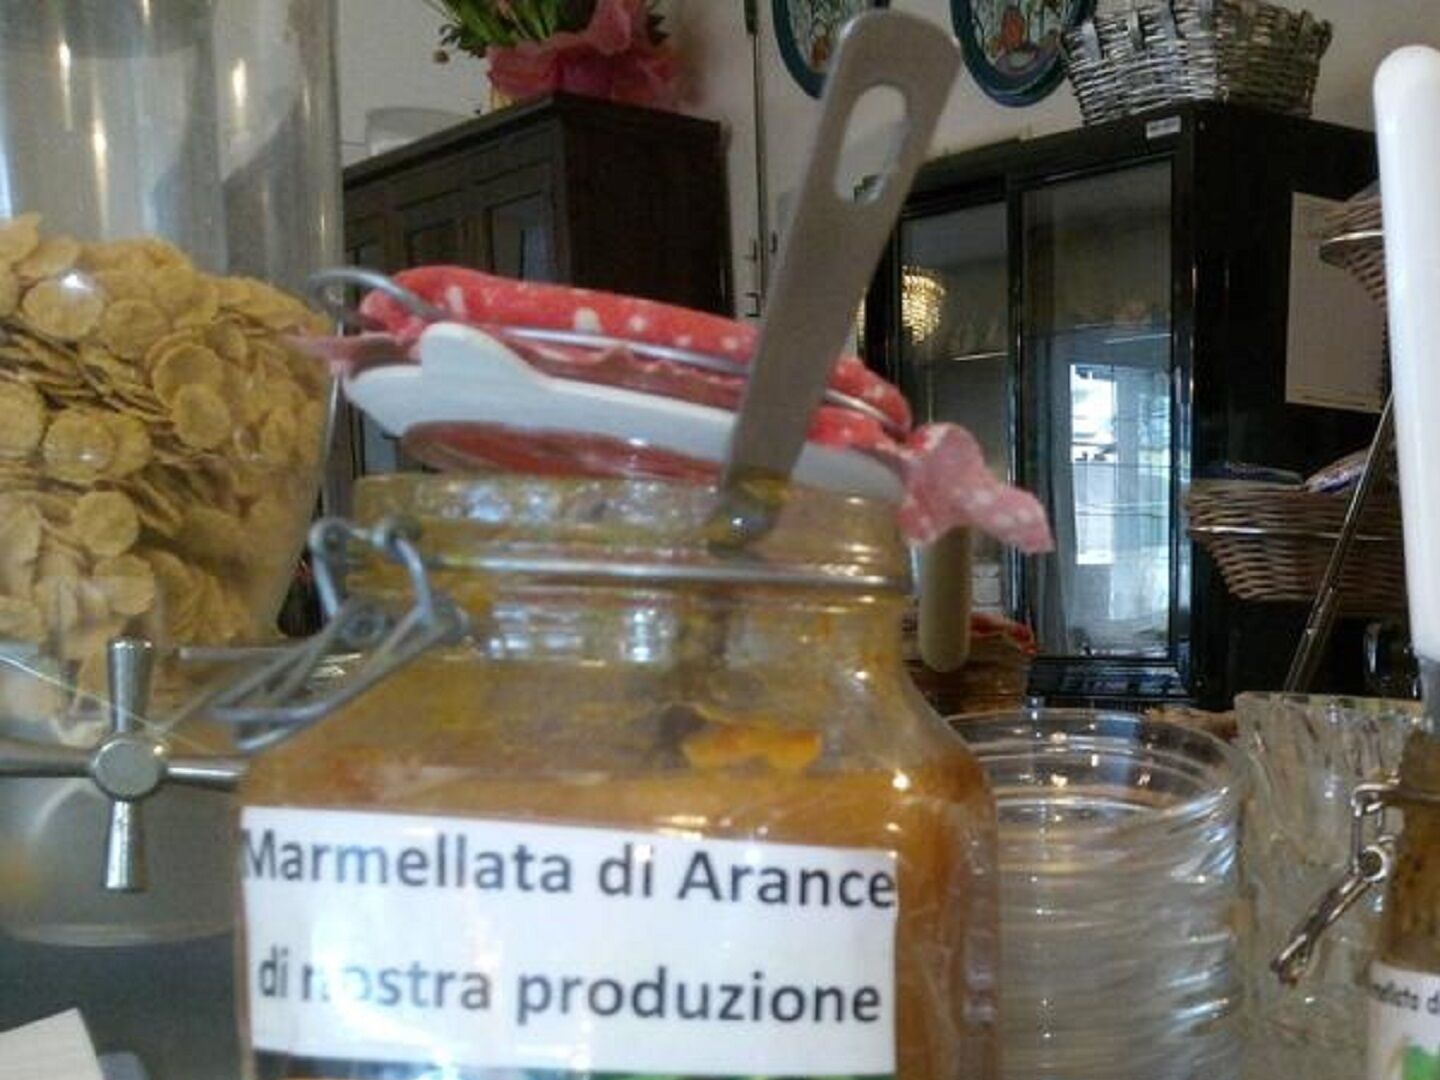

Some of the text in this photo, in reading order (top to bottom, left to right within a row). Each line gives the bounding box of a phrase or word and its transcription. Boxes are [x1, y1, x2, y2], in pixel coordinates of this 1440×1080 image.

[242, 828, 897, 909] Marmellata di Arance
[258, 945, 290, 999] di
[517, 966, 883, 1026] produzione
